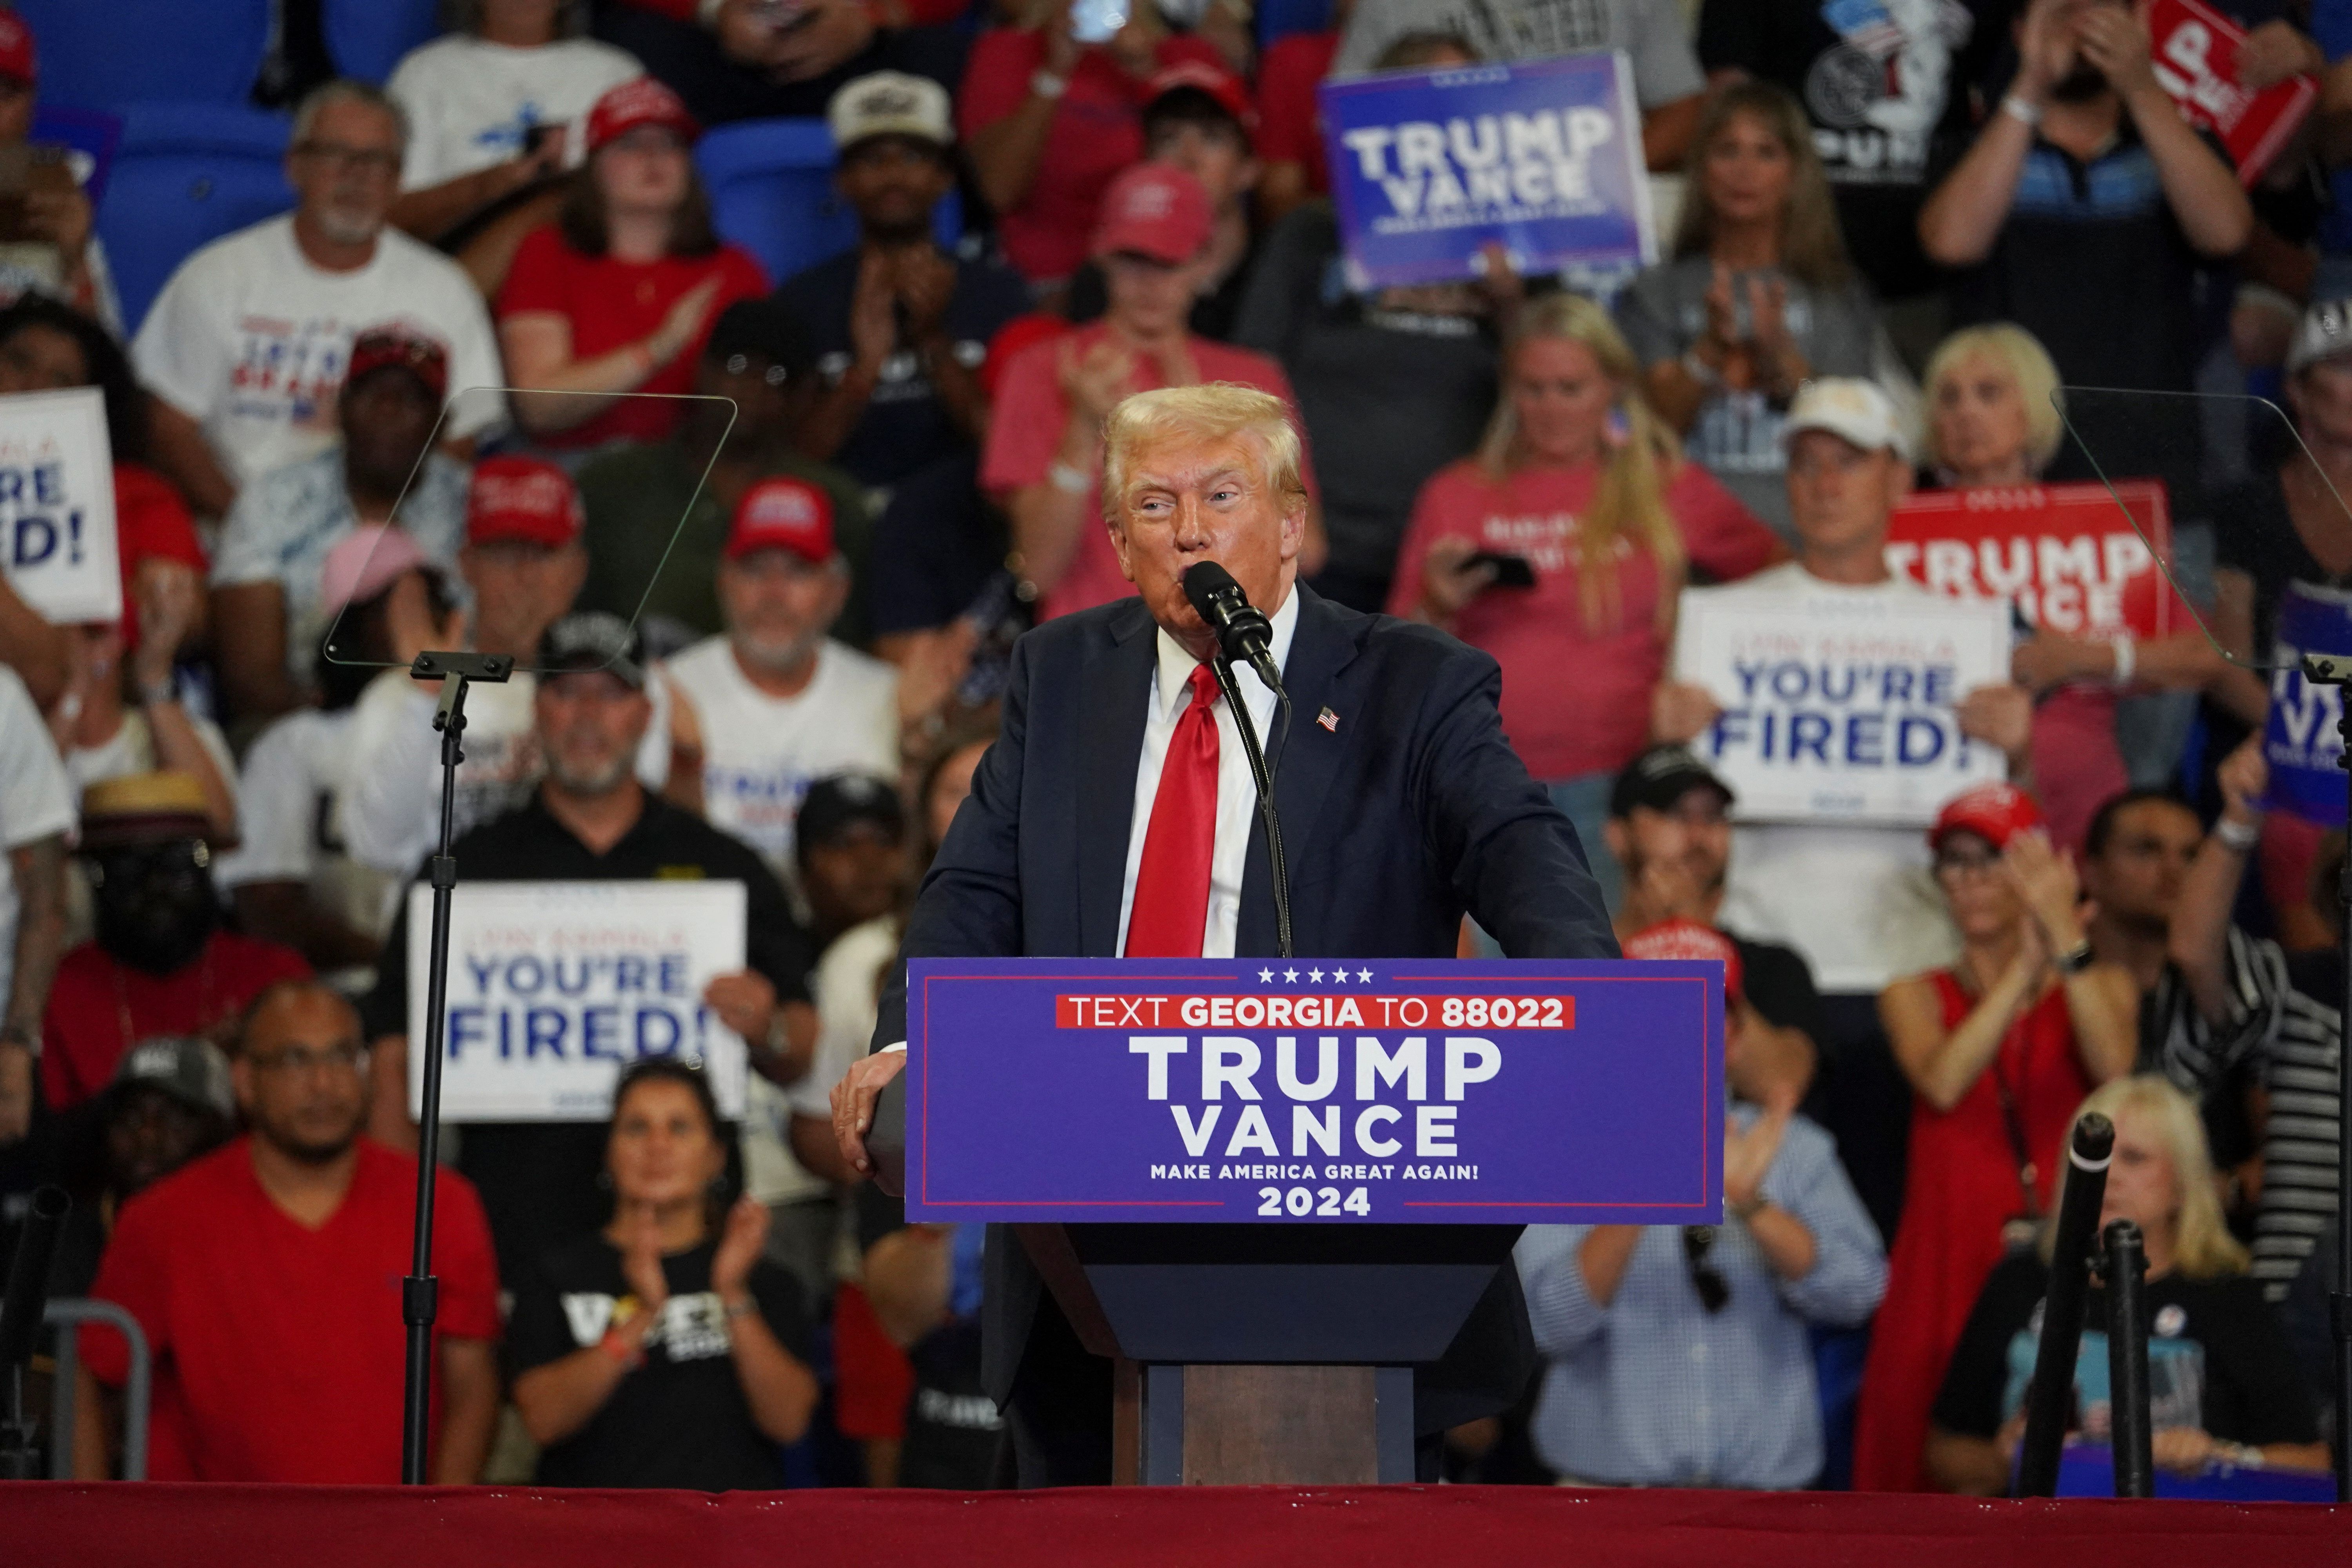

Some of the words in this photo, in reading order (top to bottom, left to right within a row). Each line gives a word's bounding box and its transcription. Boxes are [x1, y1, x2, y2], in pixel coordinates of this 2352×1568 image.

[1342, 105, 1613, 180] TRUMP
[1381, 157, 1592, 216] VANCE
[1884, 534, 2152, 589] TRUMP
[1734, 660, 1956, 705] YOU'RE
[1710, 709, 1970, 770] FIRED!
[466, 953, 688, 996] YOU'RE
[447, 1005, 709, 1059] FIRED!
[1069, 998, 1168, 1026] TEXT
[1181, 998, 1365, 1026] GEORGIA
[1376, 998, 1428, 1027] TO
[1442, 998, 1563, 1027] 88022
[1129, 1036, 1501, 1102] TRUMP
[1170, 1105, 1457, 1157] VANCE
[1151, 1164, 1210, 1180] MAKE
[1218, 1164, 1316, 1180] AMERICA
[1325, 1164, 1395, 1180] GREAT
[1403, 1164, 1478, 1180] AGAIN!
[1258, 1186, 1371, 1217] 2024
